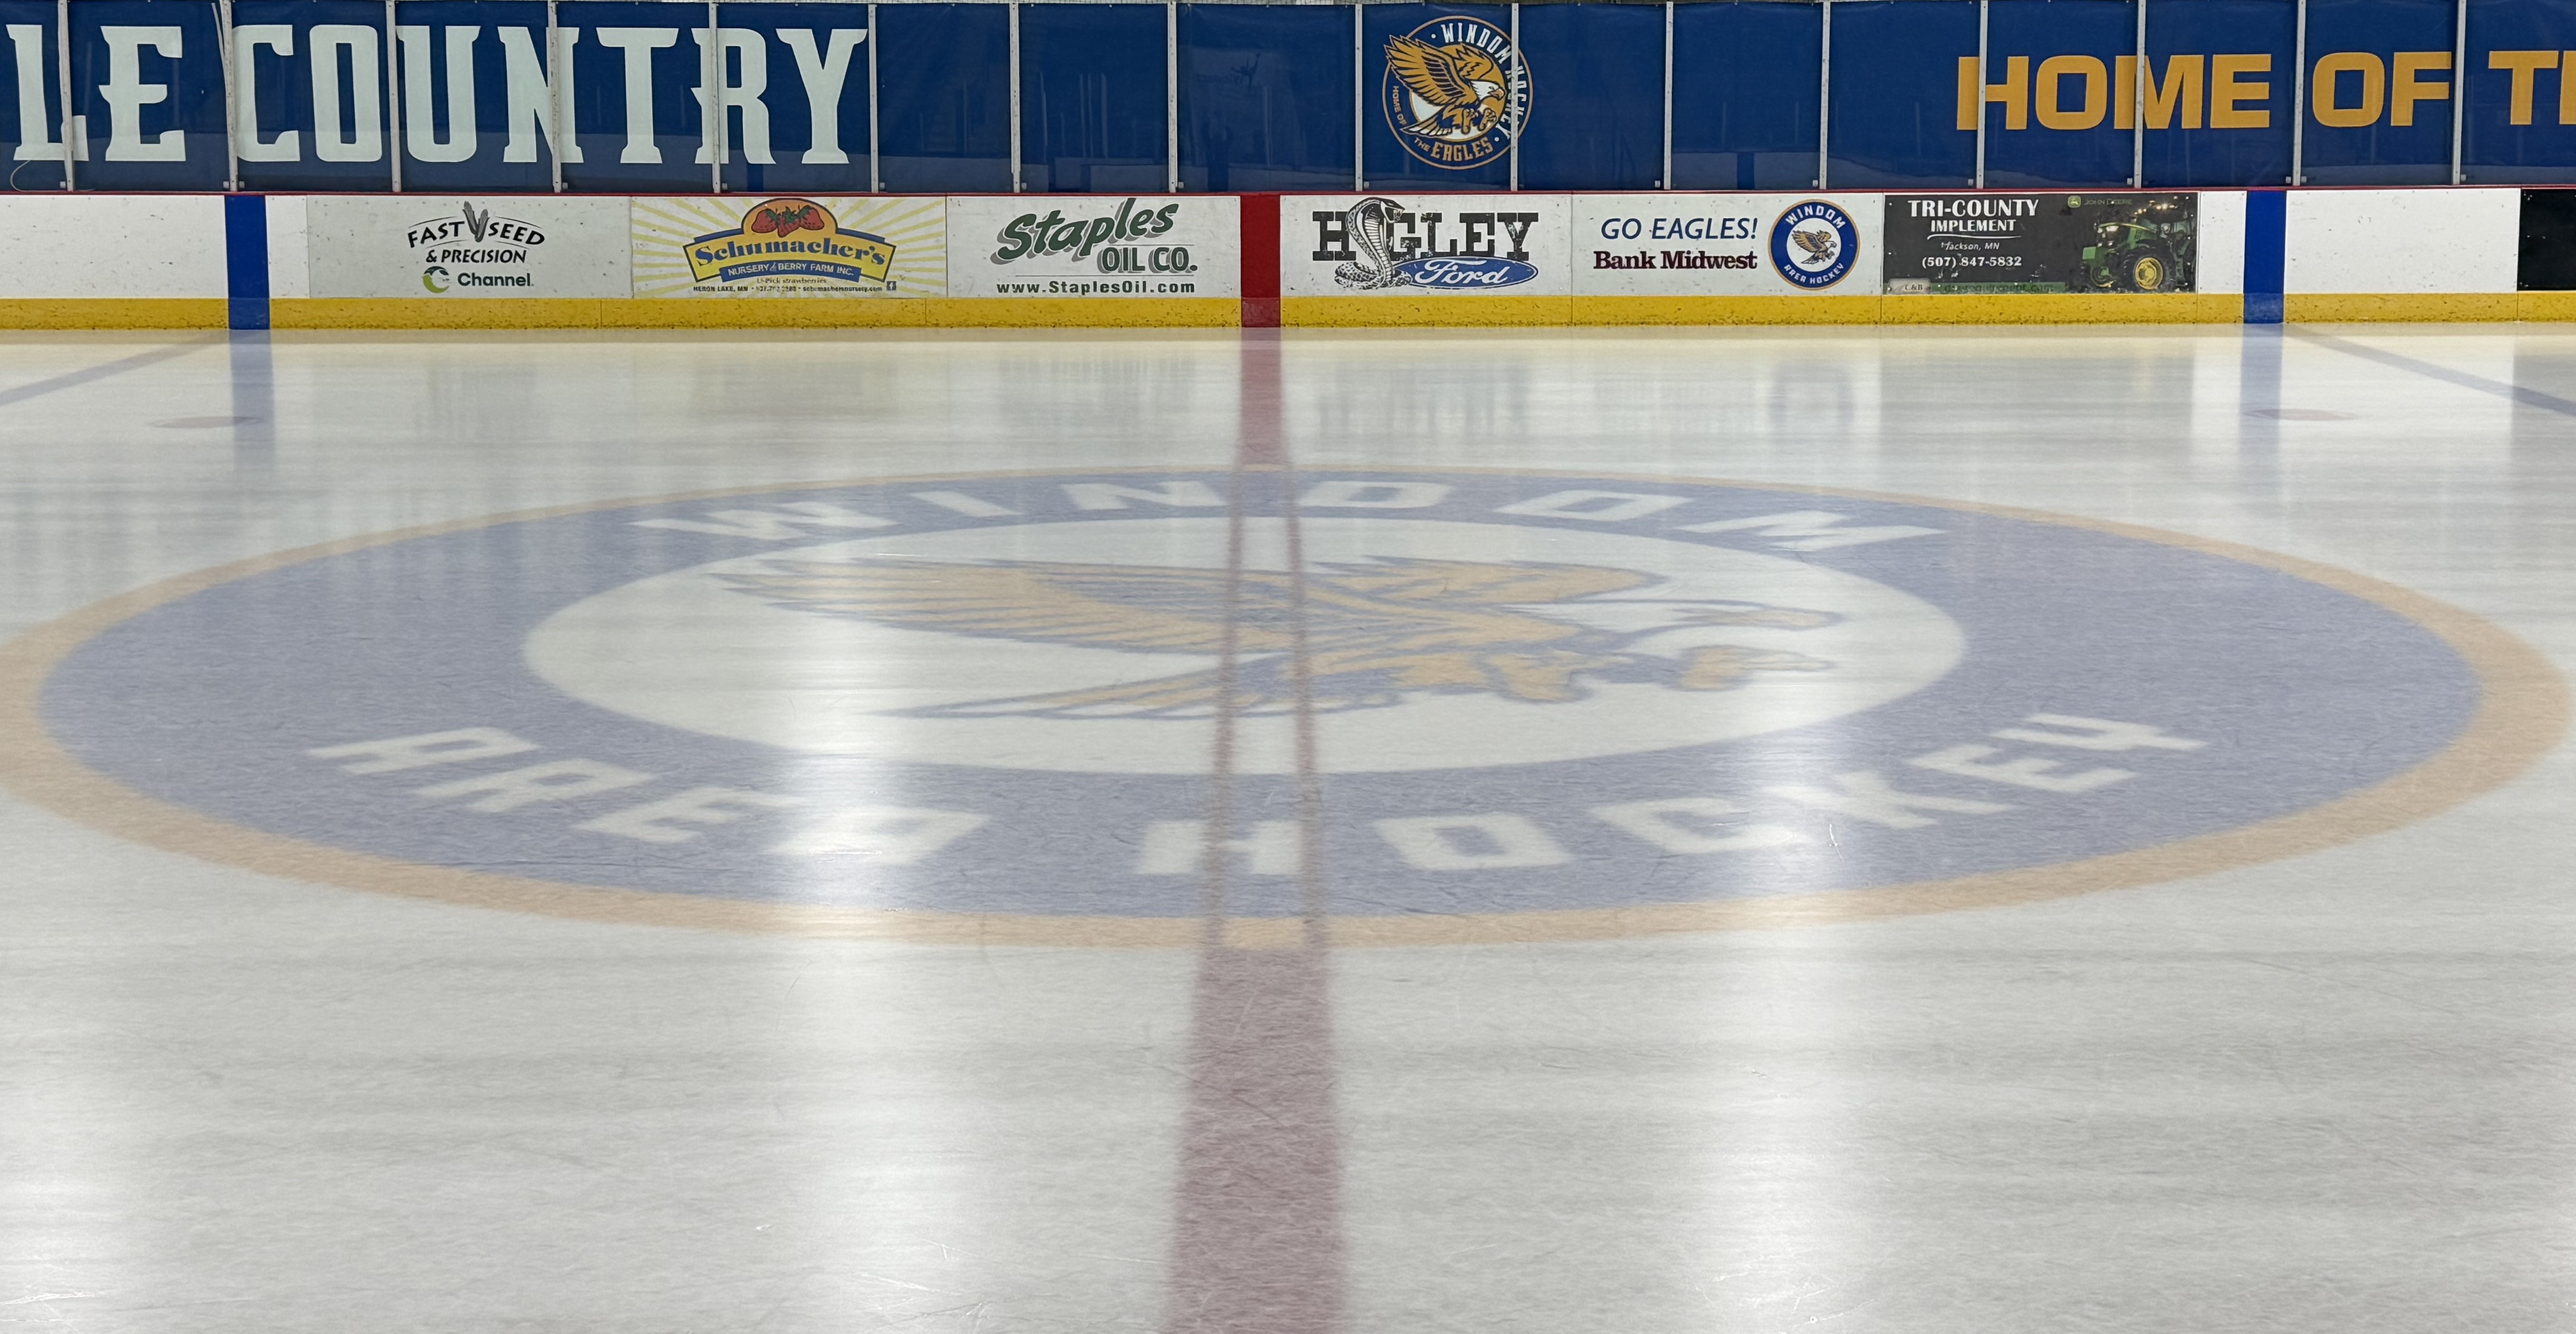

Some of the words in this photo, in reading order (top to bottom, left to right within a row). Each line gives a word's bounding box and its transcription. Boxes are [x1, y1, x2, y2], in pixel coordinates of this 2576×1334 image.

[1441, 23, 1511, 64] WINDOM
[232, 25, 867, 164] COUNTRY
[1957, 54, 2272, 131] HOME
[2312, 51, 2452, 127] OF
[2489, 51, 2576, 124] T
[1414, 137, 1431, 152] THE
[1431, 137, 1494, 161] EAGLES
[1785, 205, 1845, 229] WINDOM
[1908, 199, 2038, 217] TRI-COUNTY
[408, 221, 465, 248] FAST
[488, 222, 545, 244] SEED
[991, 198, 1179, 265] Staples
[1313, 211, 1539, 261] HGLEY
[1601, 218, 1642, 239] GO
[1652, 217, 1758, 239] EAGLES!
[1931, 219, 2016, 232] IMPLEMENT
[426, 249, 437, 263] &
[442, 249, 527, 263] PRECISION
[694, 237, 885, 267] Schumacher's
[1097, 247, 1145, 273] OIL
[1148, 247, 1198, 273] CO.
[1593, 251, 1656, 269] Bank
[1661, 250, 1757, 269] Midwest
[1922, 257, 1956, 268] (507)
[1960, 256, 2022, 267] 847-5832
[728, 264, 769, 276] NURSERY
[769, 262, 777, 272] &
[810, 263, 833, 273] FARM
[837, 266, 853, 276] INC.
[1415, 258, 1510, 285] Ford
[1784, 264, 1807, 283] AREA
[1810, 263, 1844, 284] HOCKEY
[996, 281, 1195, 295] www.StaplesOil.com
[625, 480, 1950, 552] WINDOM
[304, 725, 991, 867] AREA
[1136, 713, 2208, 876] HOCKEY
